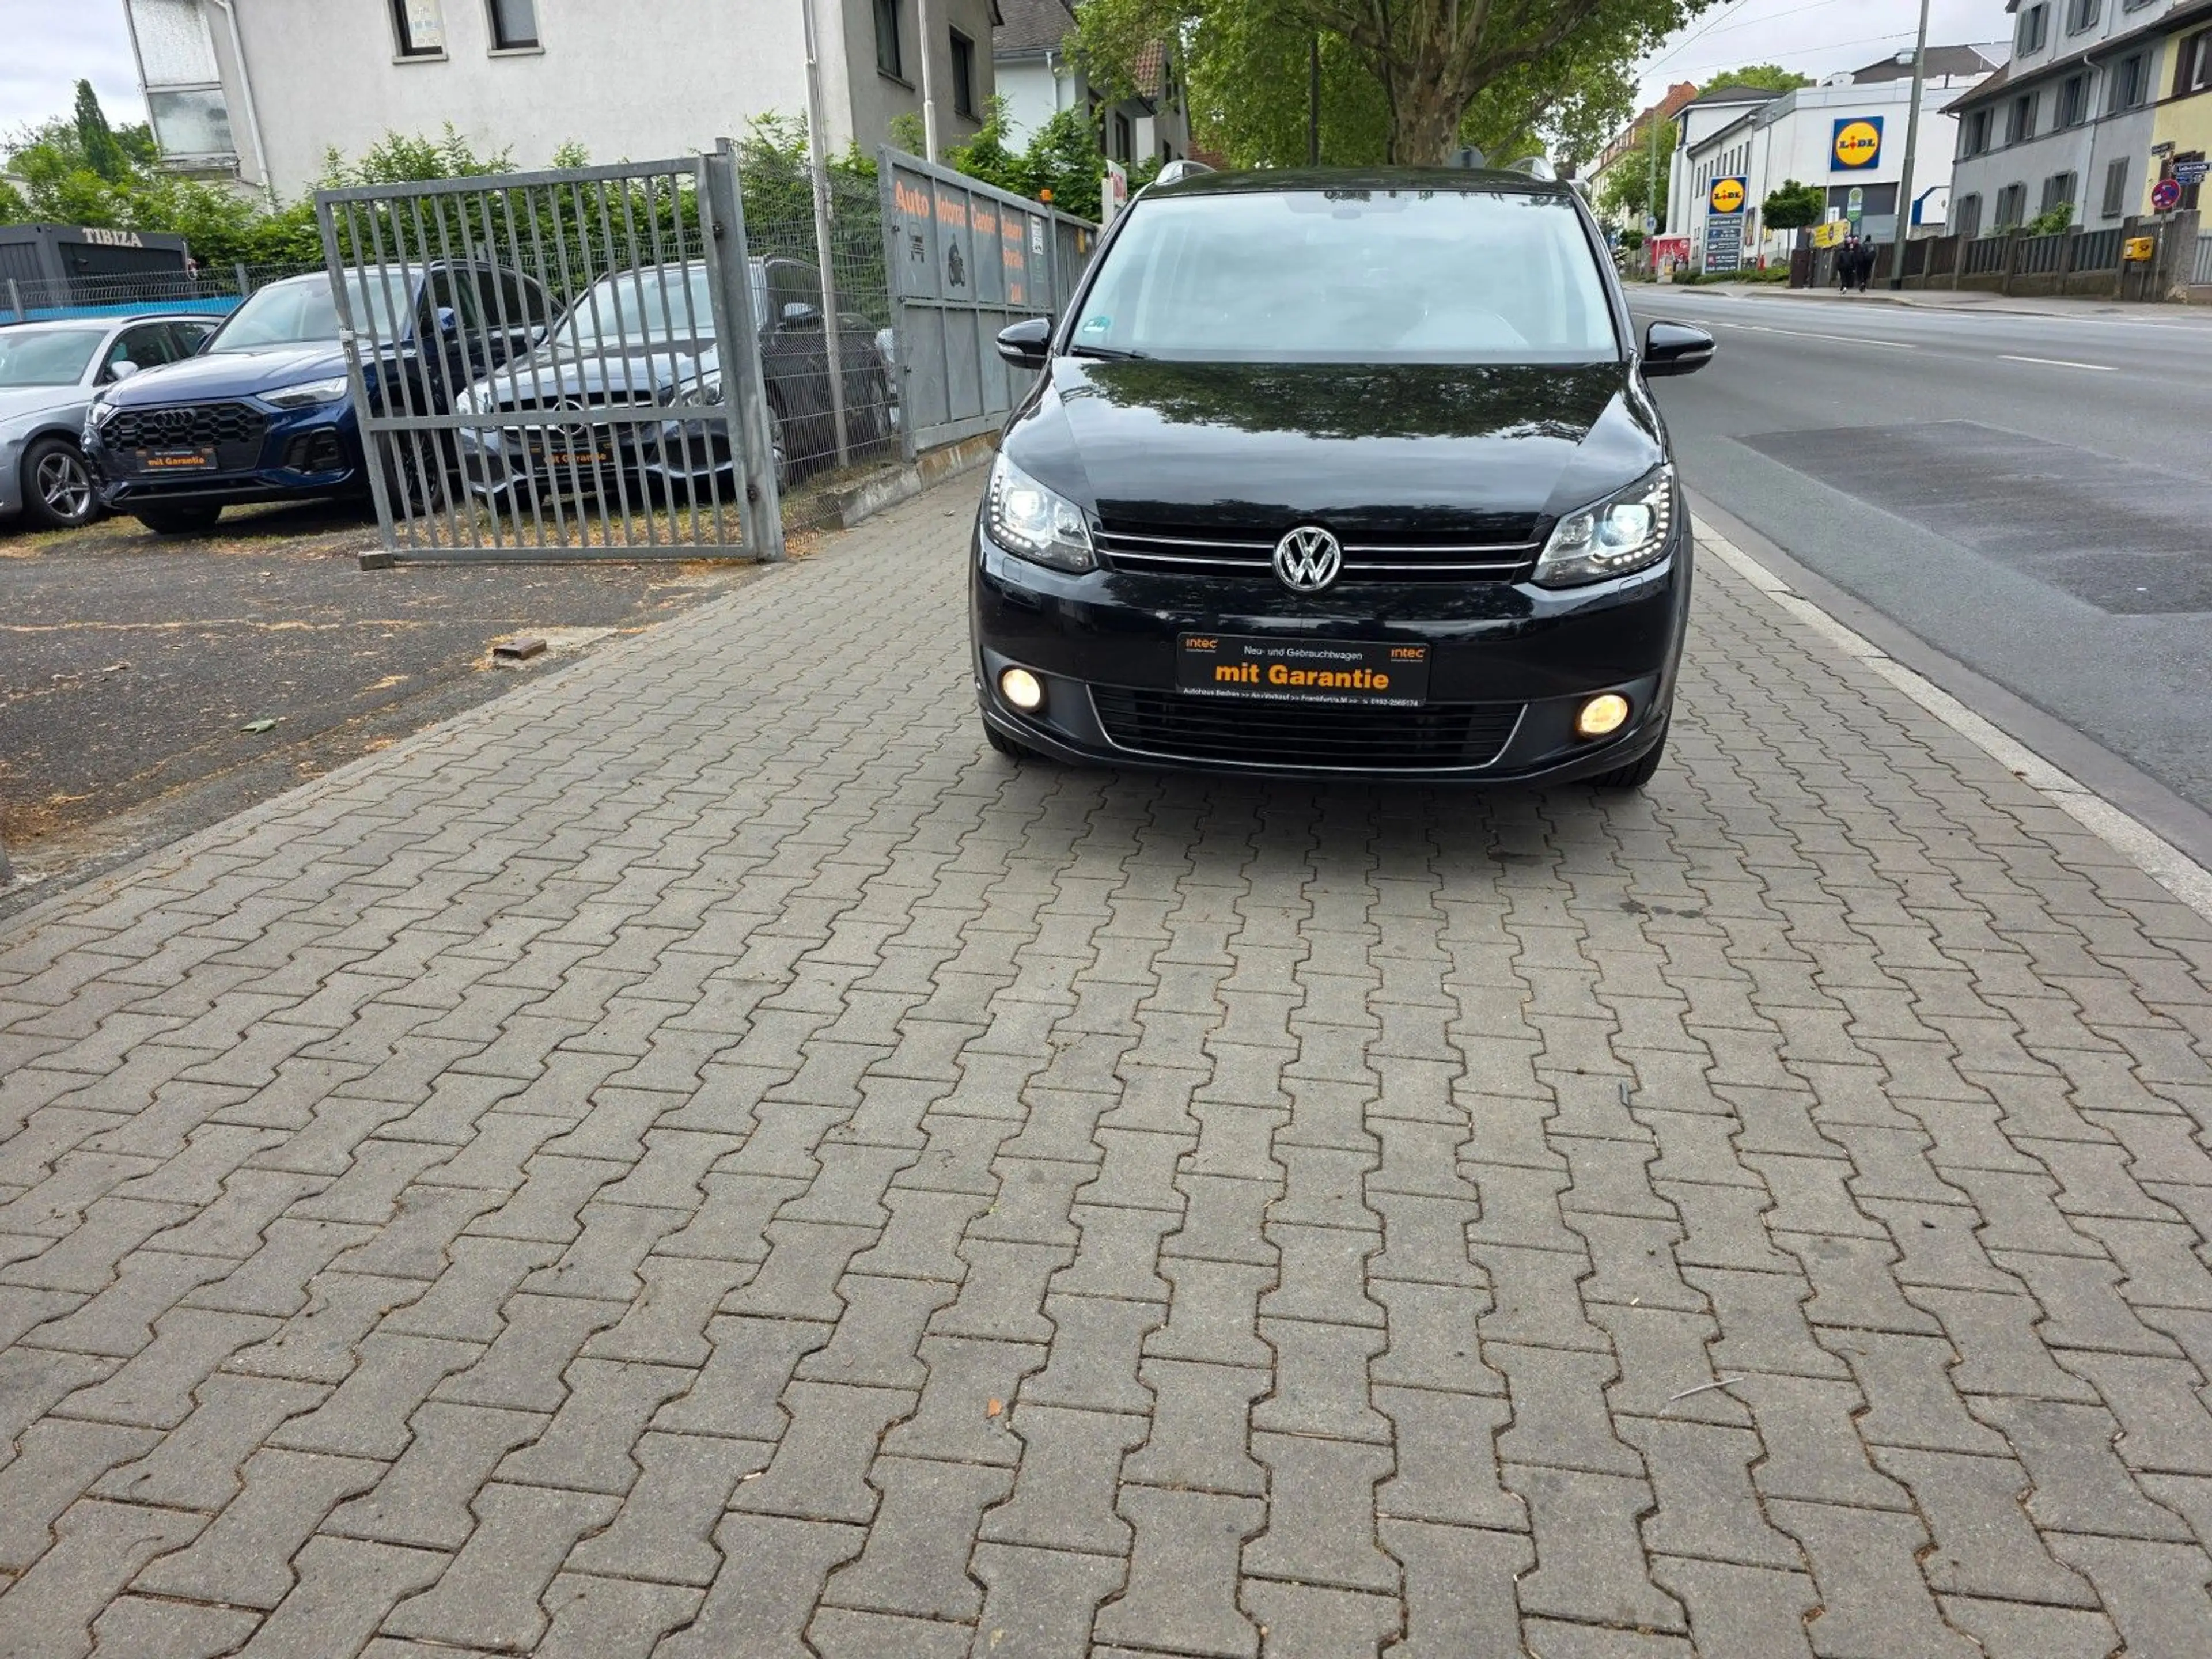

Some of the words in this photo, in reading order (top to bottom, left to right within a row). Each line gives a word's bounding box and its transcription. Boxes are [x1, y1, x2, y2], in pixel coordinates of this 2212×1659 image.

[896, 180, 929, 218] Auto
[82, 228, 143, 247] TIBIZA
[165, 456, 205, 464] Garantie
[1185, 638, 1218, 649] intec
[1267, 648, 1285, 656] und
[1286, 648, 1362, 661] Gebrauchtwagen
[1391, 648, 1425, 658] intec
[1215, 662, 1260, 683] mit
[1268, 664, 1389, 690] Garantie
